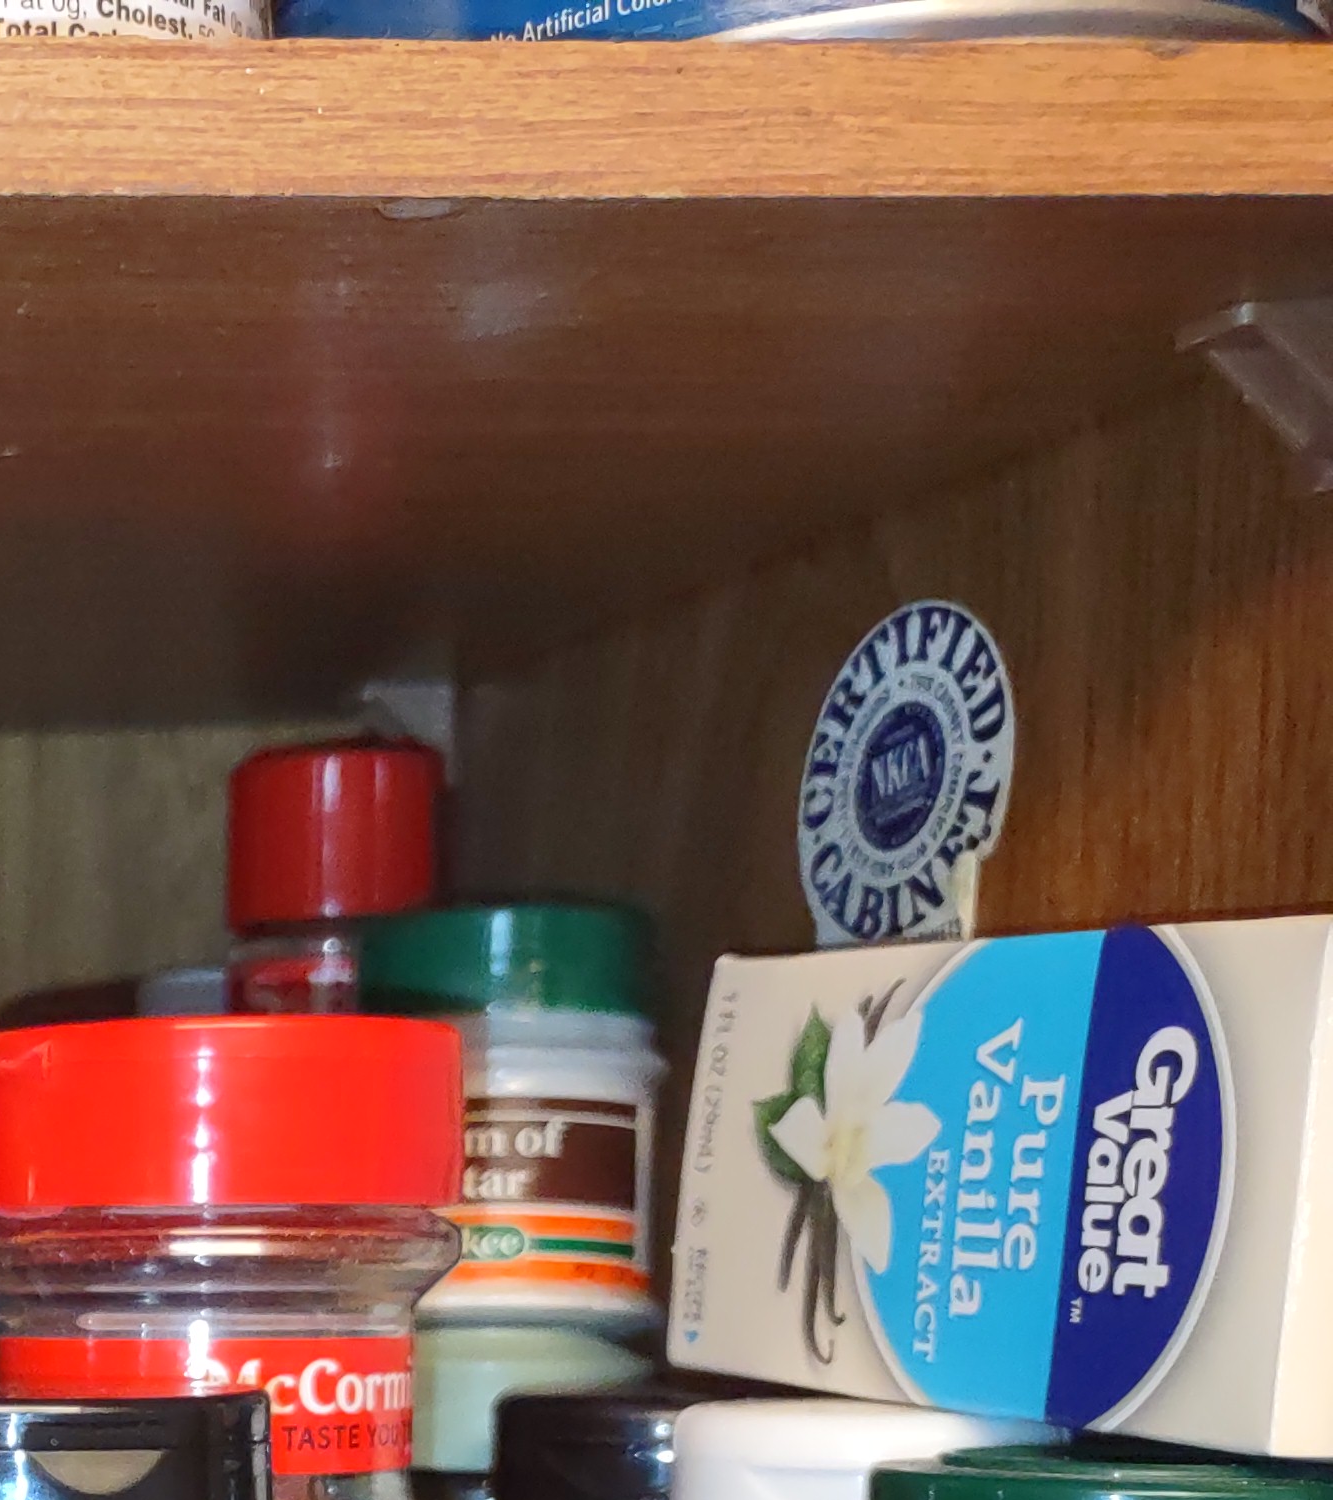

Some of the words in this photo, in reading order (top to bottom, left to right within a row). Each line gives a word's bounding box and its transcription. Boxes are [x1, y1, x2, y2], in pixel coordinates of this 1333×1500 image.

[523, 0, 610, 42] Artificial
[912, 1147, 952, 1364] EXTRACT
[948, 1016, 1025, 1320] Vanilla
[1002, 1073, 1068, 1272] Pure
[1078, 1090, 1134, 1294] Value
[1111, 1025, 1200, 1299] Great
[282, 1422, 361, 1452] TASTE
